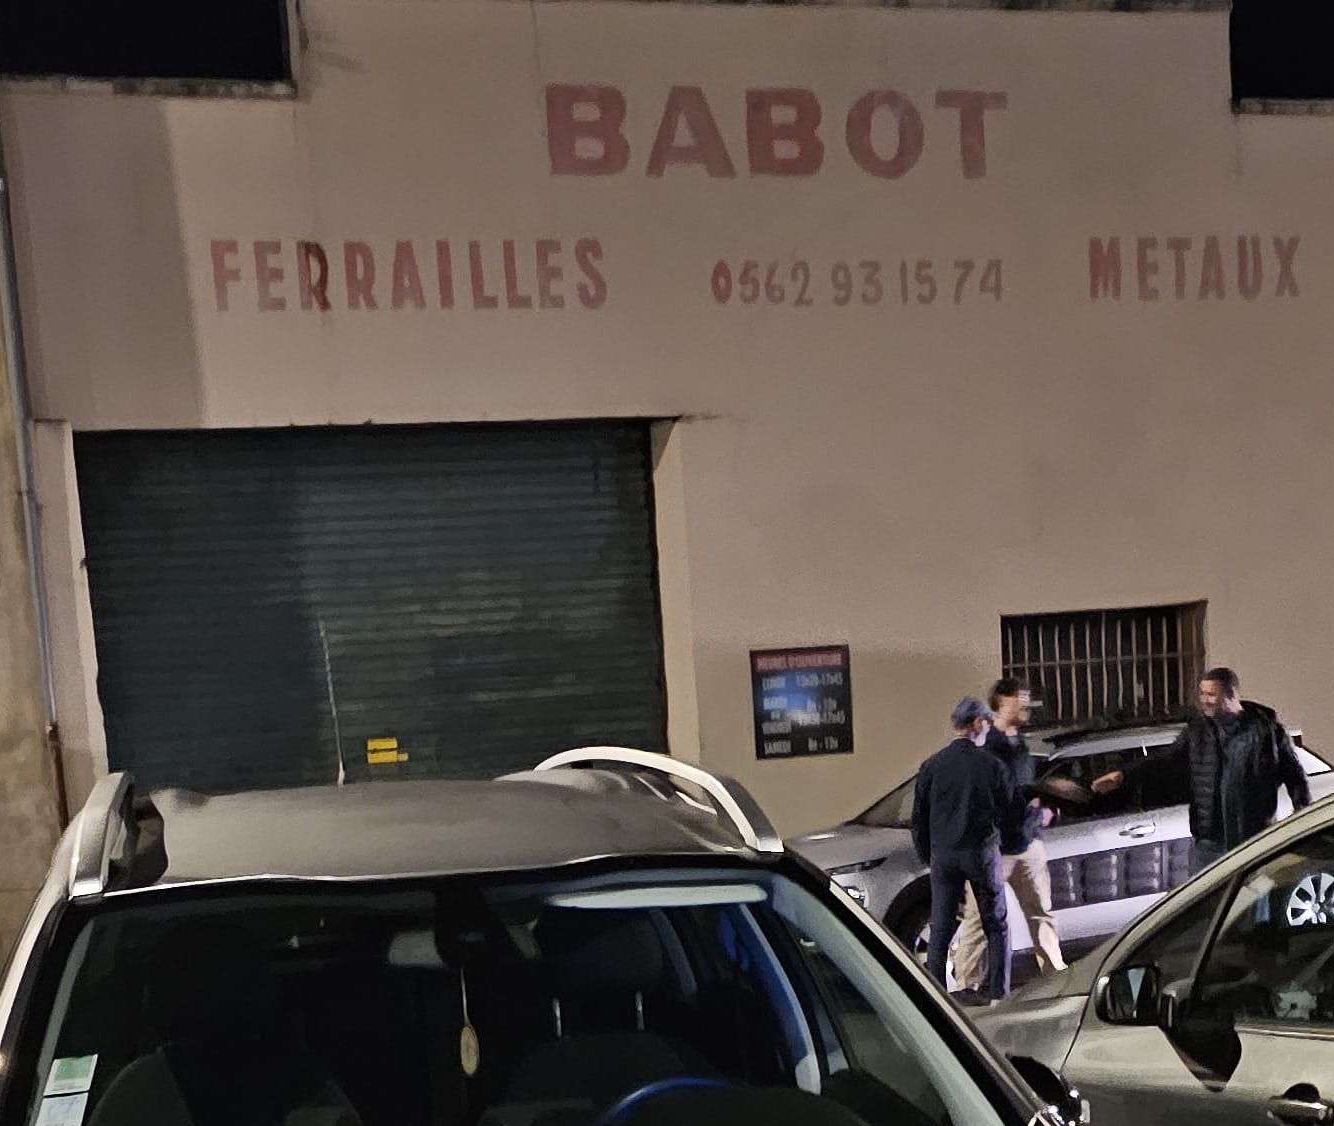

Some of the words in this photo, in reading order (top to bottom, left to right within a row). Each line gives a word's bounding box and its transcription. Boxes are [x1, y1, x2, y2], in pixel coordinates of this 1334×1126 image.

[544, 82, 1008, 180] BABOT
[210, 238, 608, 313] FERRAILLES
[710, 258, 814, 306] 0562
[1088, 234, 1301, 302] METAUX
